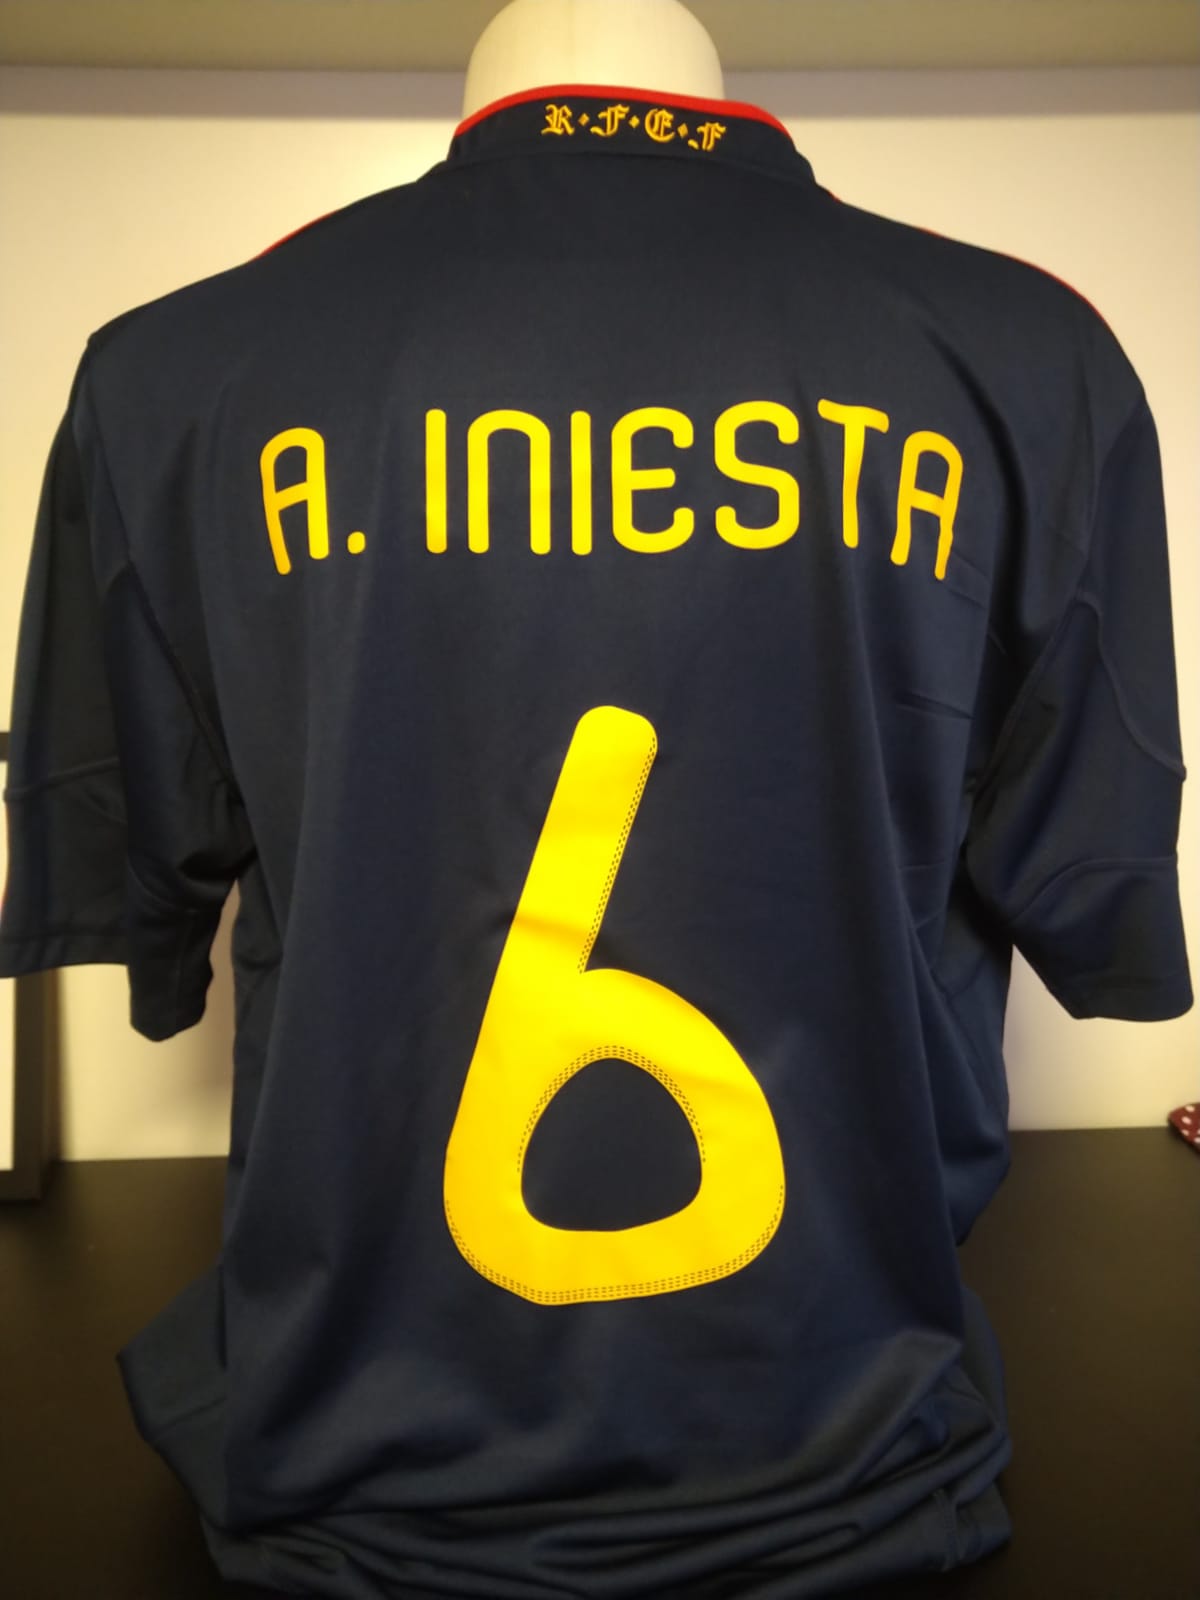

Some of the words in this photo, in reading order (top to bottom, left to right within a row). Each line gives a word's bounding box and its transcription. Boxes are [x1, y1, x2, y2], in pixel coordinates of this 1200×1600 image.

[259, 426, 368, 576] A.
[424, 398, 965, 581] INIESTA
[442, 704, 787, 1307] 6
